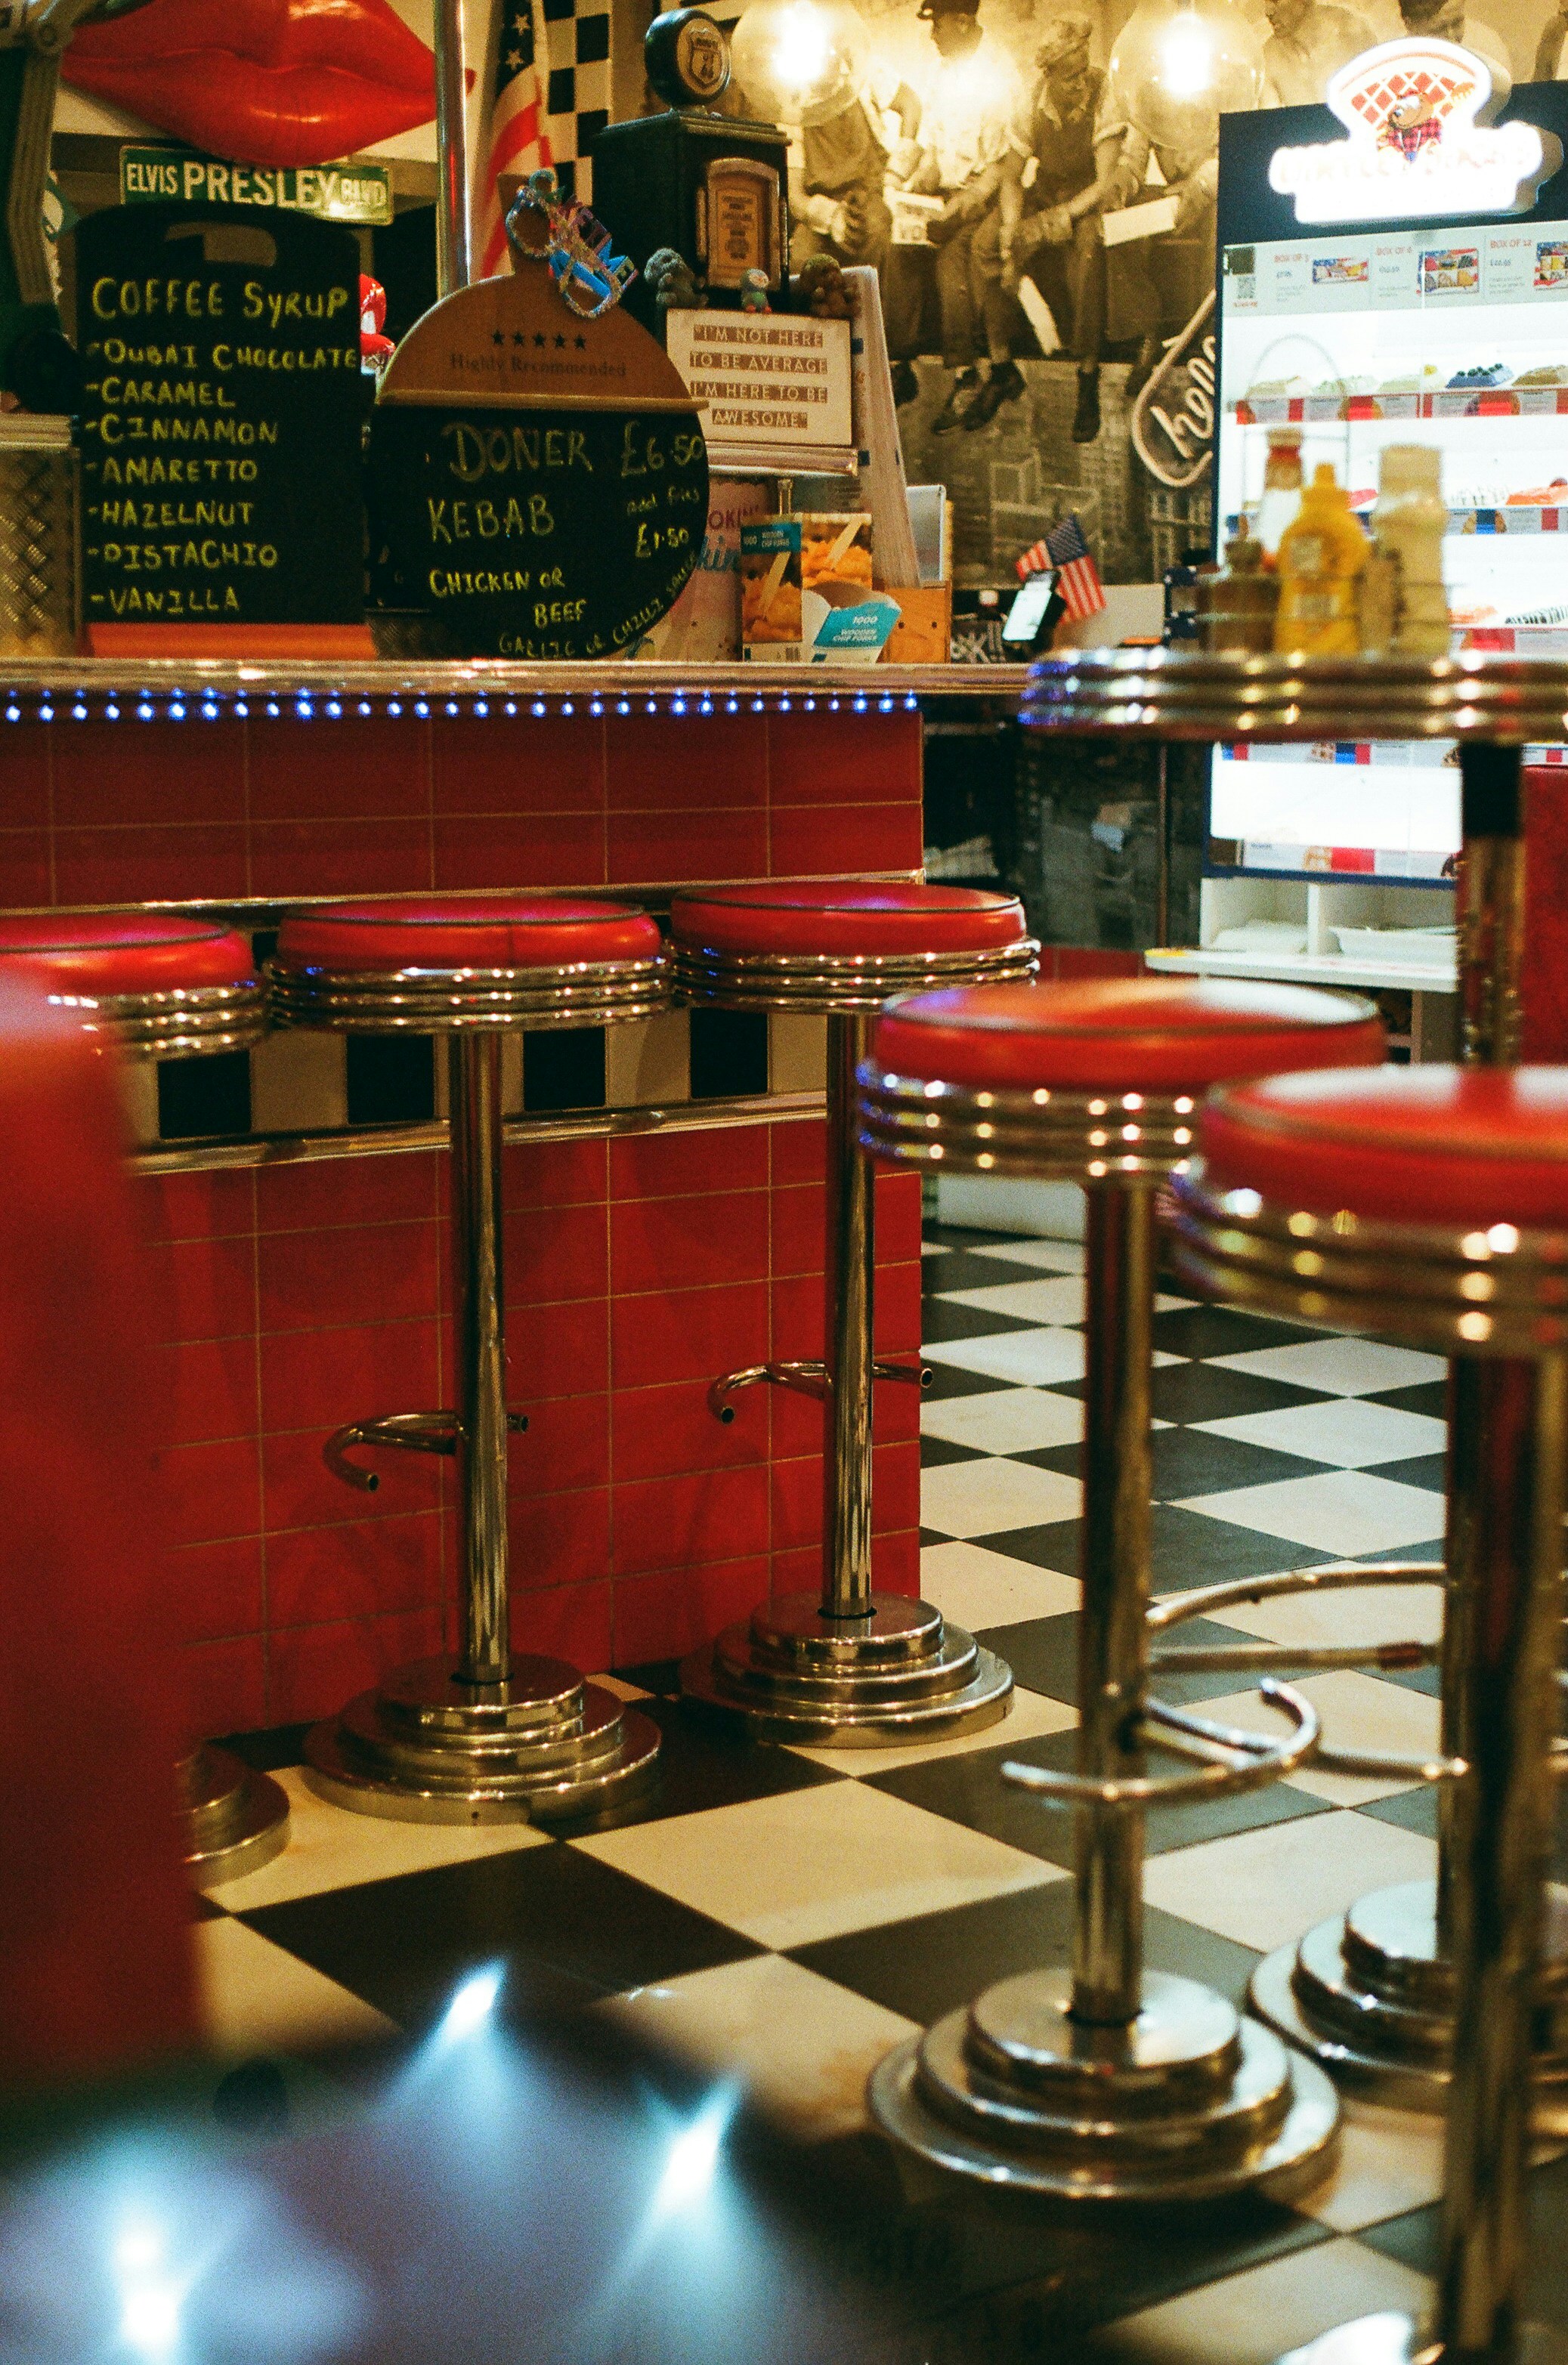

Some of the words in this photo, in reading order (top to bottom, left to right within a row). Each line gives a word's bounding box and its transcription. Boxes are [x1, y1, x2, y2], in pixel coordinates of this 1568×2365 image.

[126, 163, 177, 194] ELVIS
[183, 161, 339, 209] PRESLEY
[91, 277, 224, 320] COFFEE
[736, 328, 770, 344] NOT
[779, 330, 823, 348] HERE
[212, 345, 357, 371] CHOCOLATE
[692, 351, 713, 367] TO
[721, 353, 741, 369] BE
[748, 354, 827, 373] AVERAGE
[694, 382, 718, 397] I'M
[726, 382, 770, 400] HERE
[779, 385, 799, 401] TO
[807, 387, 827, 403] BE
[441, 421, 593, 482] DONER
[427, 493, 555, 544] KEBAB
[428, 568, 530, 598] CHICKEN
[539, 567, 565, 589] OR
[533, 598, 587, 629] BEEF
